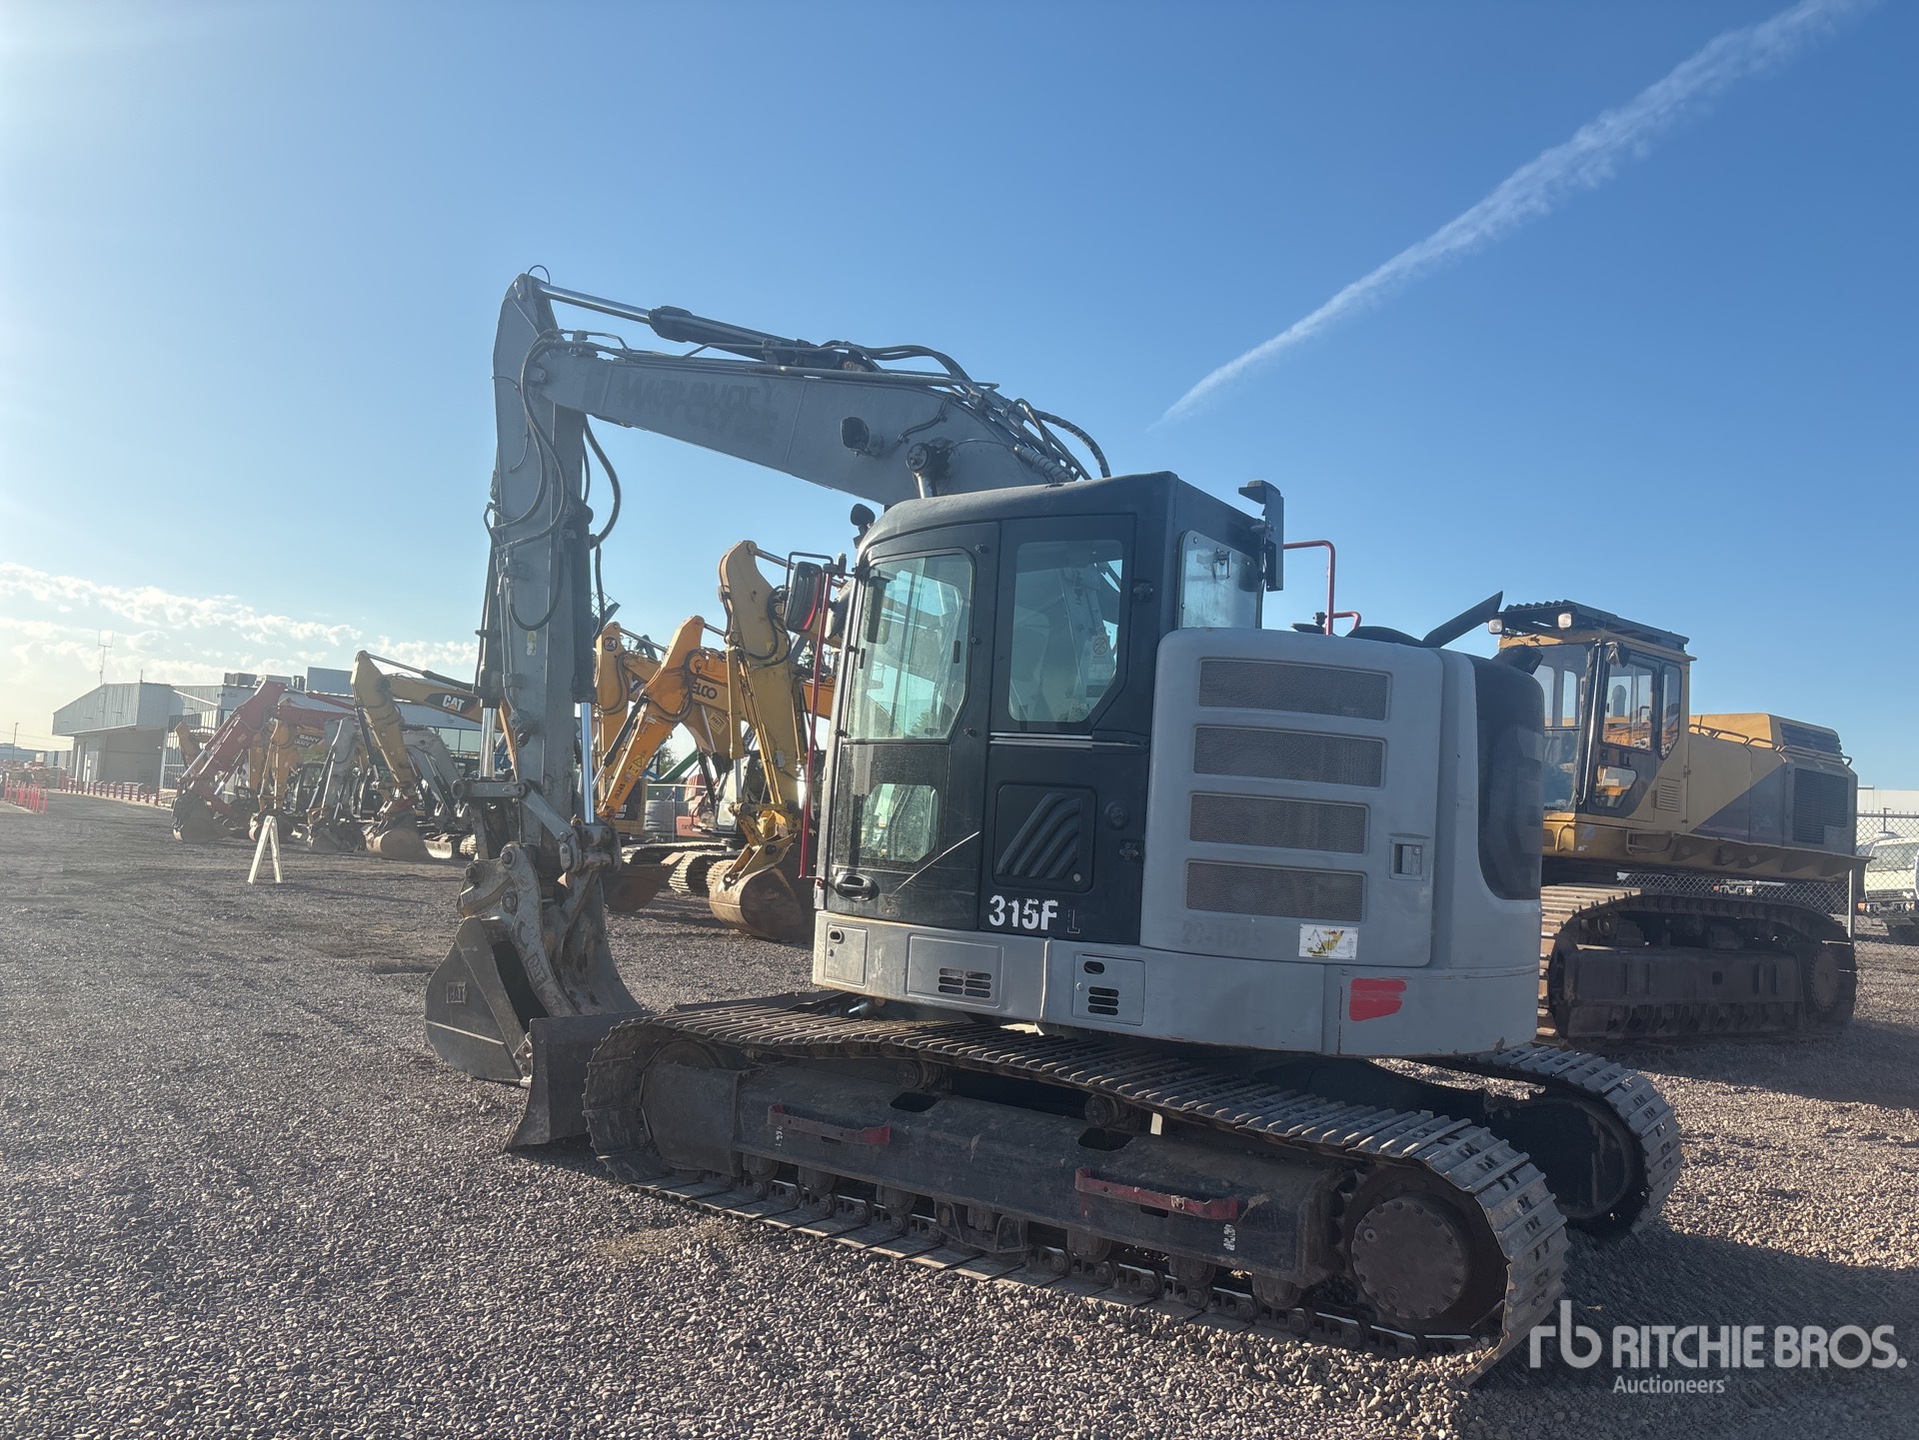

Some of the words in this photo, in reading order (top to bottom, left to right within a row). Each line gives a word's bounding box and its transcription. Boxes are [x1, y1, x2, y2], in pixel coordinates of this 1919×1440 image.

[442, 694, 465, 711] CAT
[300, 734, 320, 742] SANY
[988, 895, 1059, 930] 315F
[447, 983, 466, 1002] CAT
